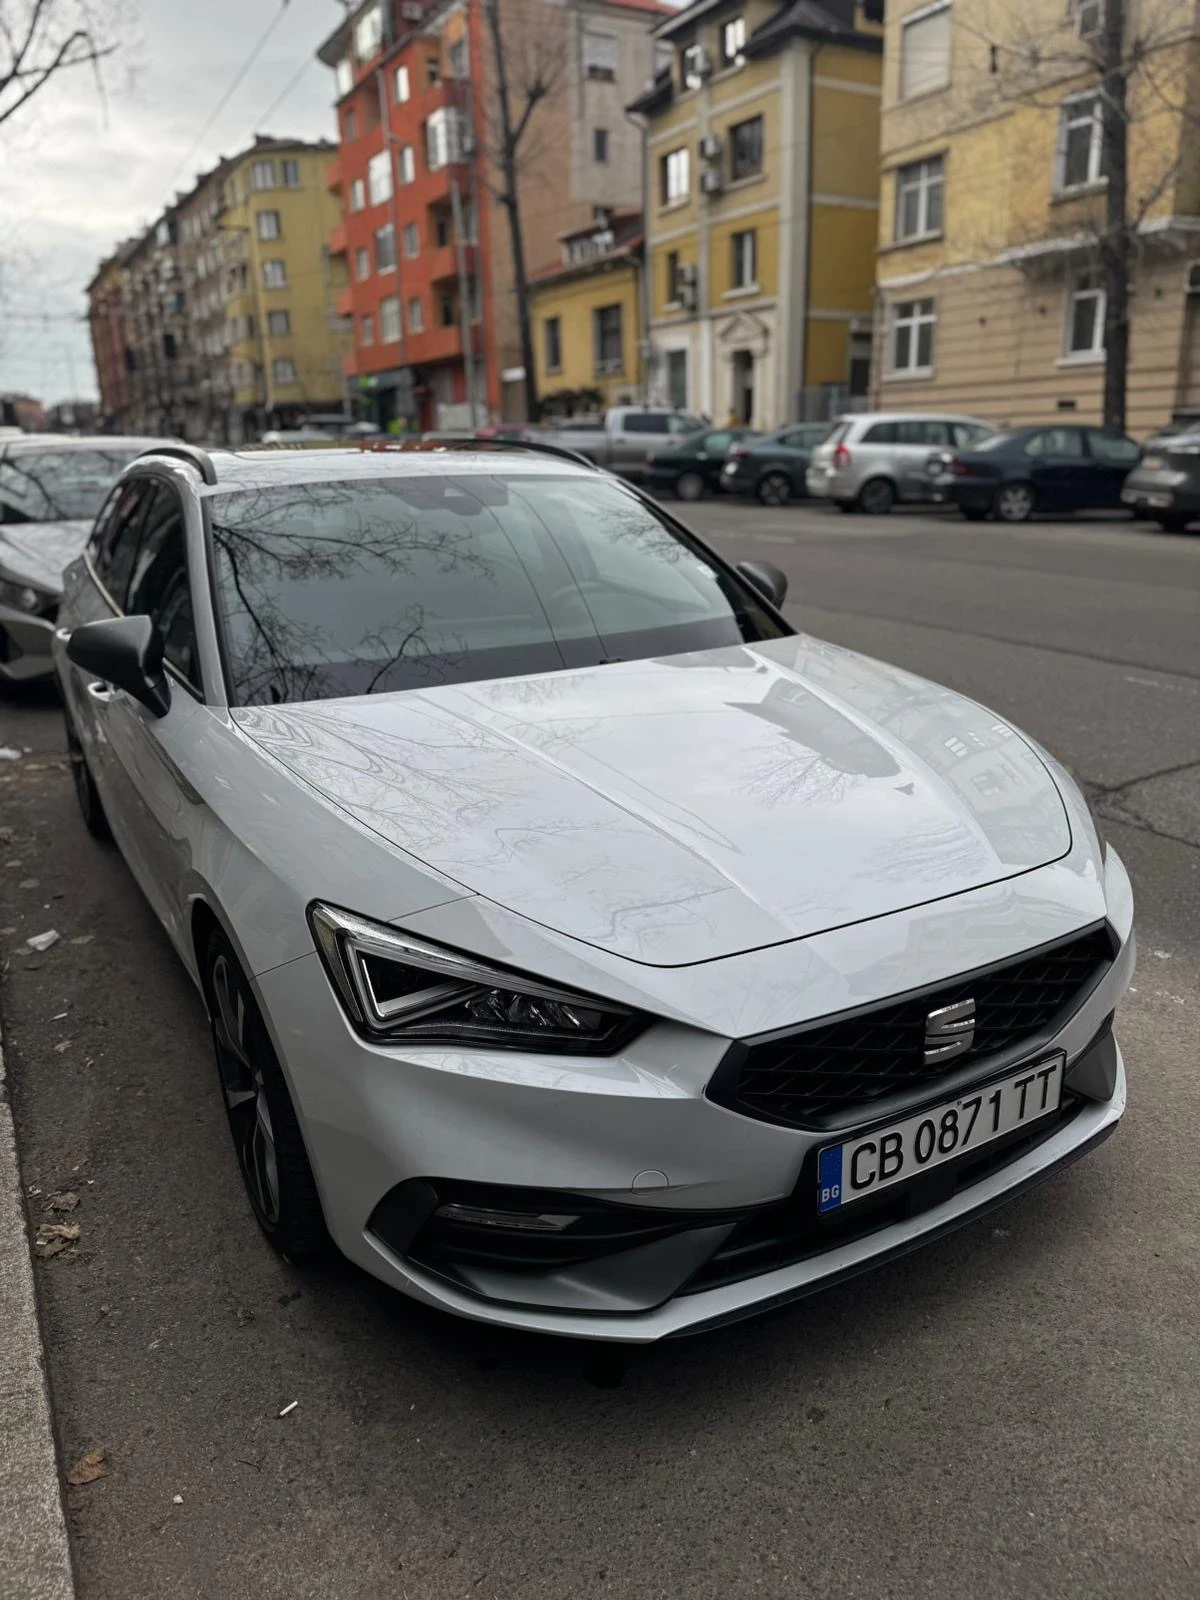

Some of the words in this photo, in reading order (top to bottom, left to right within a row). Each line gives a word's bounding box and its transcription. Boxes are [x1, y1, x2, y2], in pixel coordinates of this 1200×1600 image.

[851, 1132, 903, 1190] CB
[914, 1089, 1001, 1164] 0871
[1014, 1065, 1057, 1120] TT
[821, 1185, 840, 1202] BG
